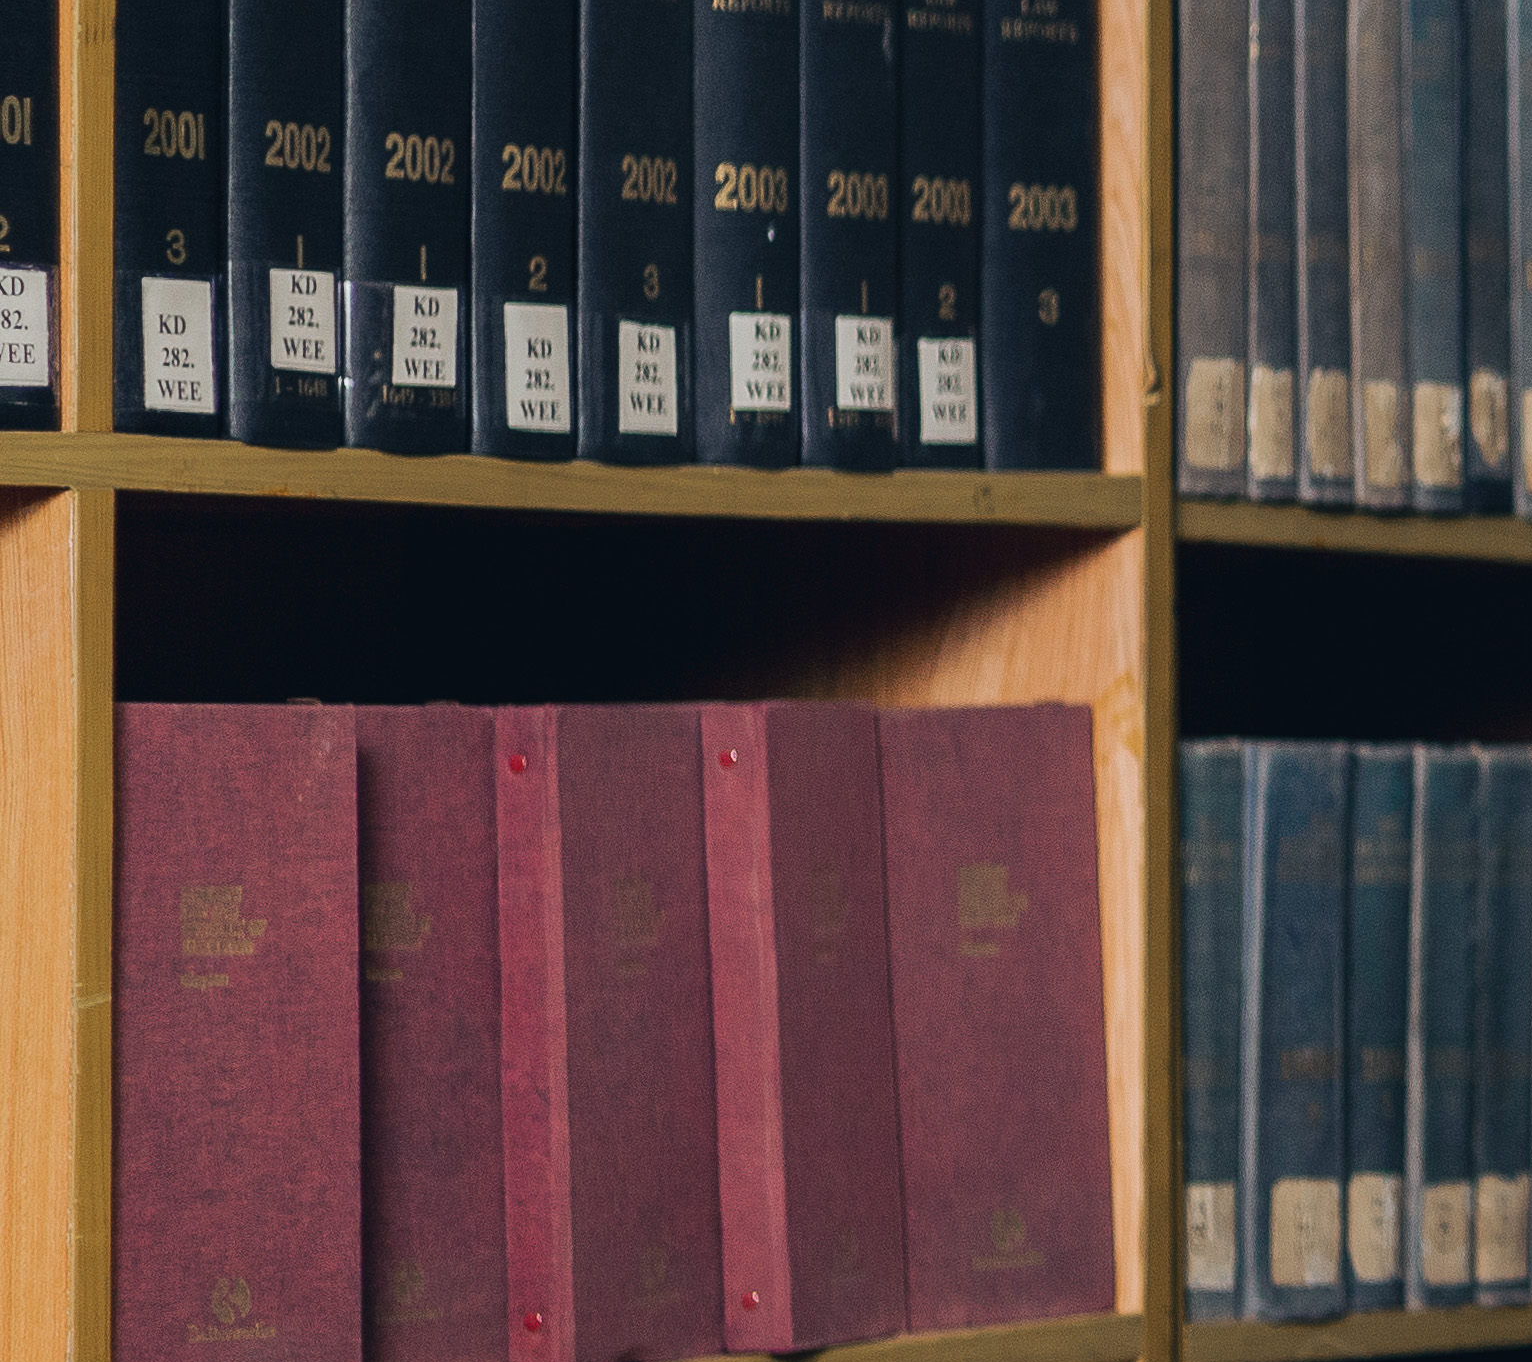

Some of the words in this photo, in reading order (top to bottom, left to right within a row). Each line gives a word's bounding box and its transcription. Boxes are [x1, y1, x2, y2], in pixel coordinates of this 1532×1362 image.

[142, 106, 207, 161] 2001
[264, 118, 333, 175] 2002
[384, 132, 456, 185] 2002
[501, 143, 567, 197] 2002
[620, 153, 679, 206] 2002
[714, 162, 790, 216] 2003
[165, 227, 188, 266] 3
[290, 272, 319, 296] KD
[529, 255, 548, 292] 2
[643, 264, 661, 300] 3
[287, 304, 321, 329] 282.
[413, 295, 440, 318] KD
[157, 313, 188, 336] KD
[755, 321, 782, 341] KD
[282, 336, 327, 362] WEE
[409, 326, 442, 349] 282.
[527, 337, 553, 360] KD
[637, 331, 661, 354] KD
[161, 346, 197, 370] 282.
[404, 357, 447, 381] WEE
[157, 378, 204, 403] WEE
[520, 399, 562, 423] WEE
[629, 392, 667, 417] WEE
